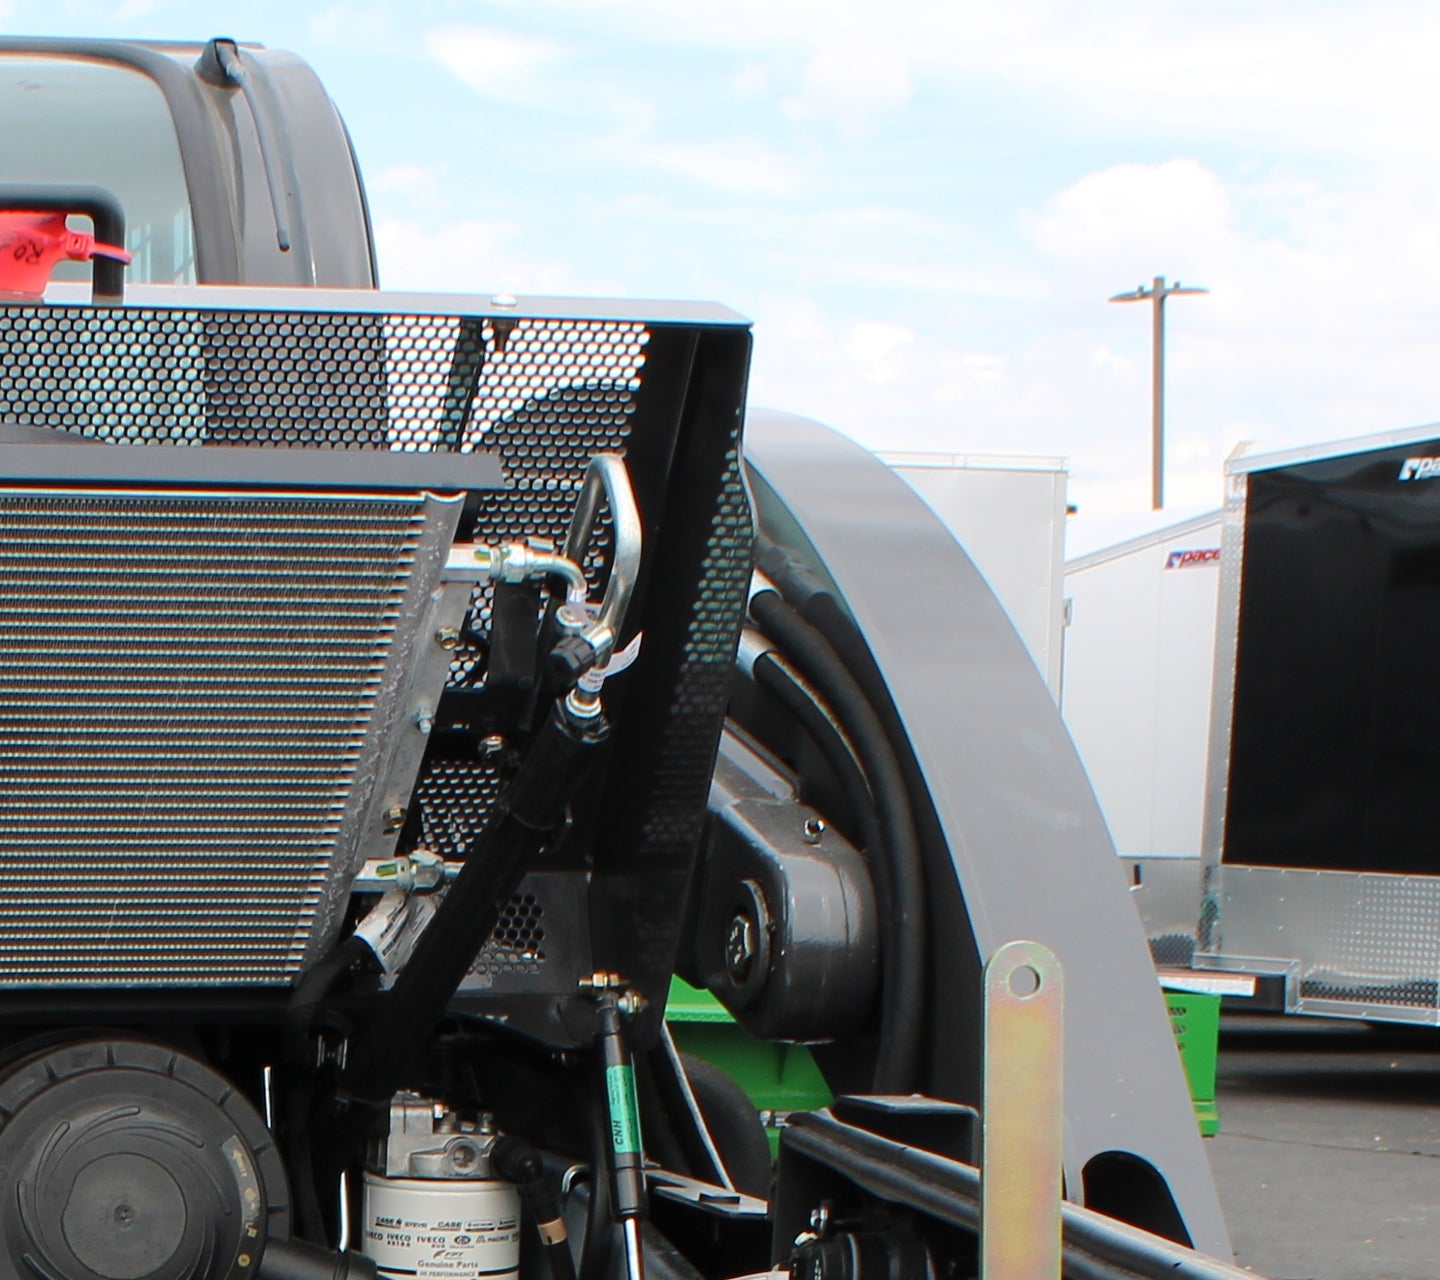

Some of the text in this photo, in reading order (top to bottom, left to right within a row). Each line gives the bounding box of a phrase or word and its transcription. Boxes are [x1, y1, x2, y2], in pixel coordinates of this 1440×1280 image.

[613, 1120, 624, 1145] CNH
[416, 1235, 446, 1244] IVECO
[417, 1260, 479, 1269] Genuine Parts
